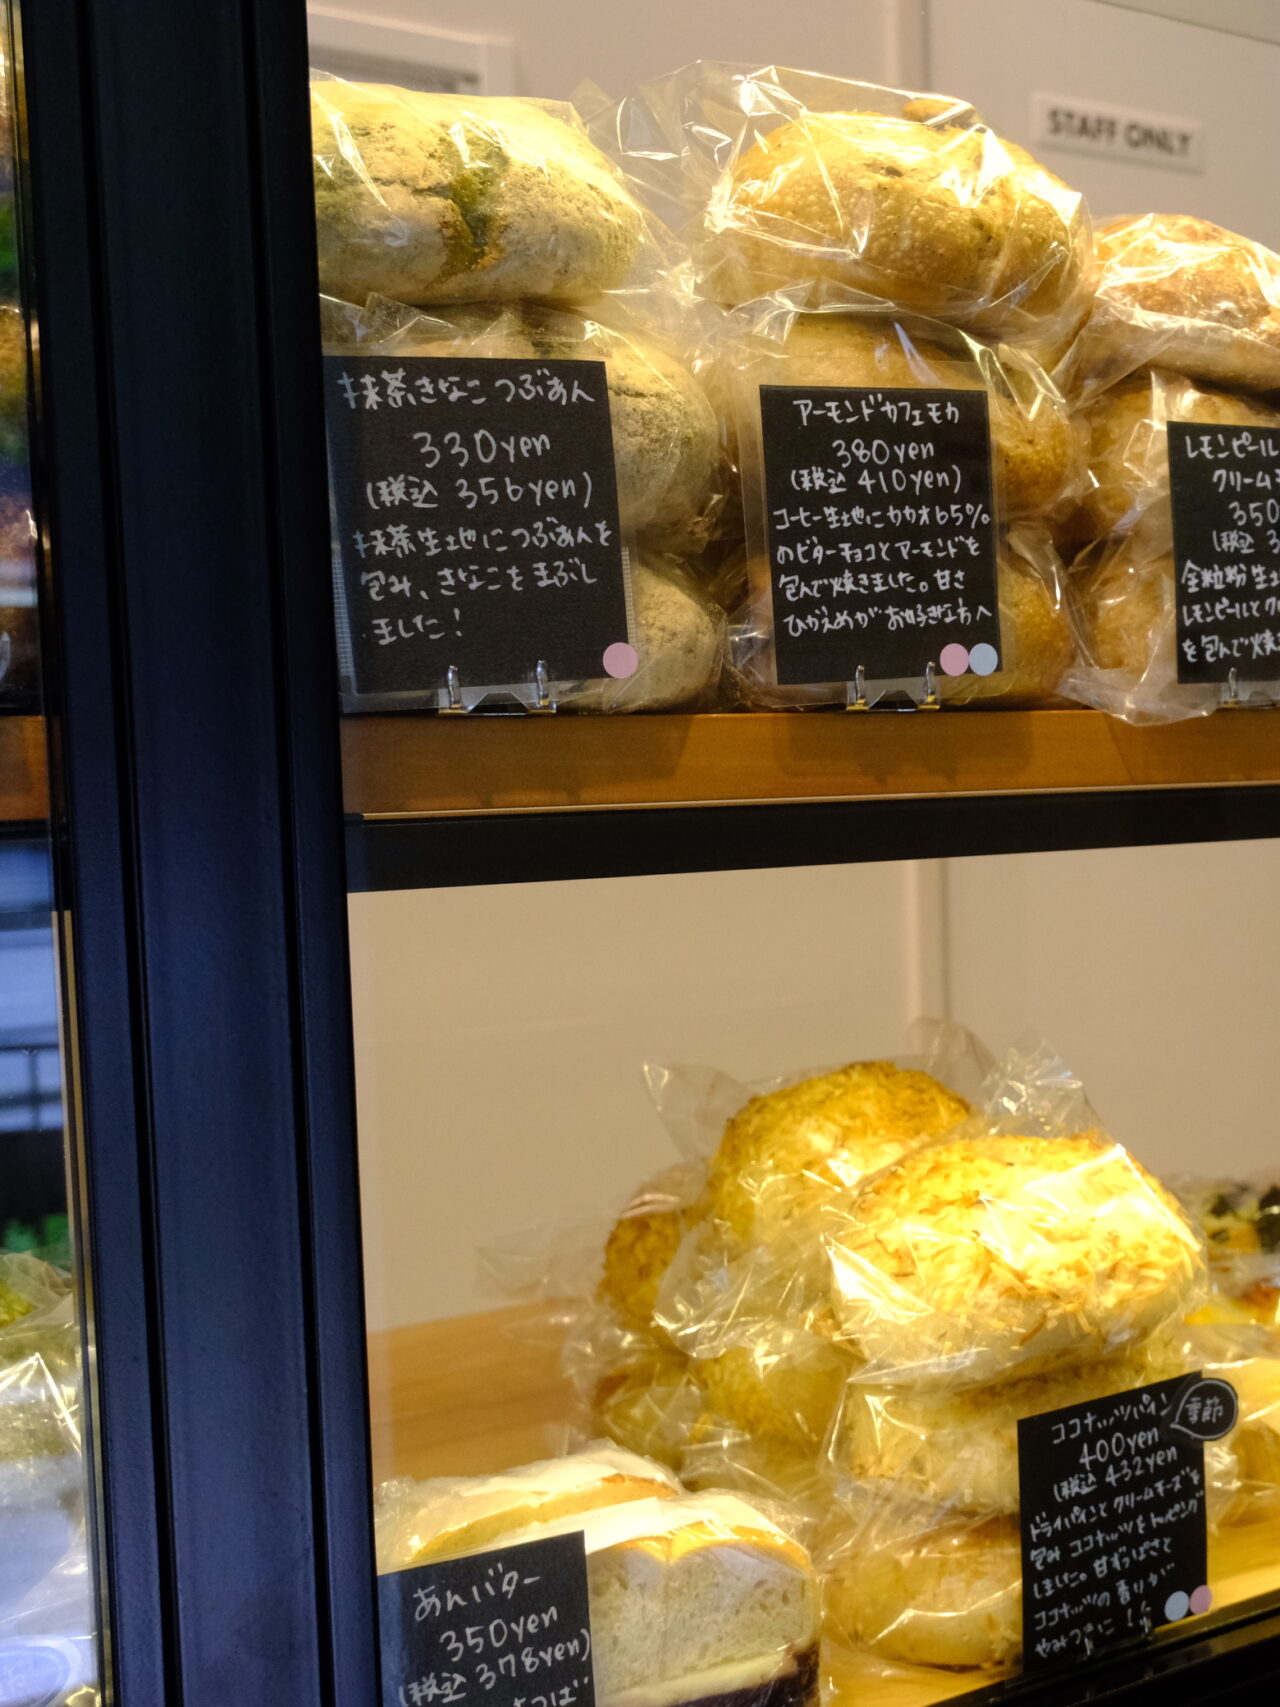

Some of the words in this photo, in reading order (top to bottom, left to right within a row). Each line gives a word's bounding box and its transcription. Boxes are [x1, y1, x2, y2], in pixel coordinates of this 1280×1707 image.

[1048, 109, 1117, 144] STAFF
[1125, 121, 1193, 155] ONLY
[793, 393, 960, 426] アーモンドカフェモカ
[412, 429, 551, 468] 330yen
[832, 438, 935, 468] 380yen
[858, 464, 962, 496] 410yen)
[1185, 1397, 1224, 1424] 季節
[1079, 1426, 1160, 1470] 400yen
[413, 1562, 541, 1622] あんバター
[440, 1606, 558, 1662] 350yen
[475, 1628, 591, 1690] 378yen)
